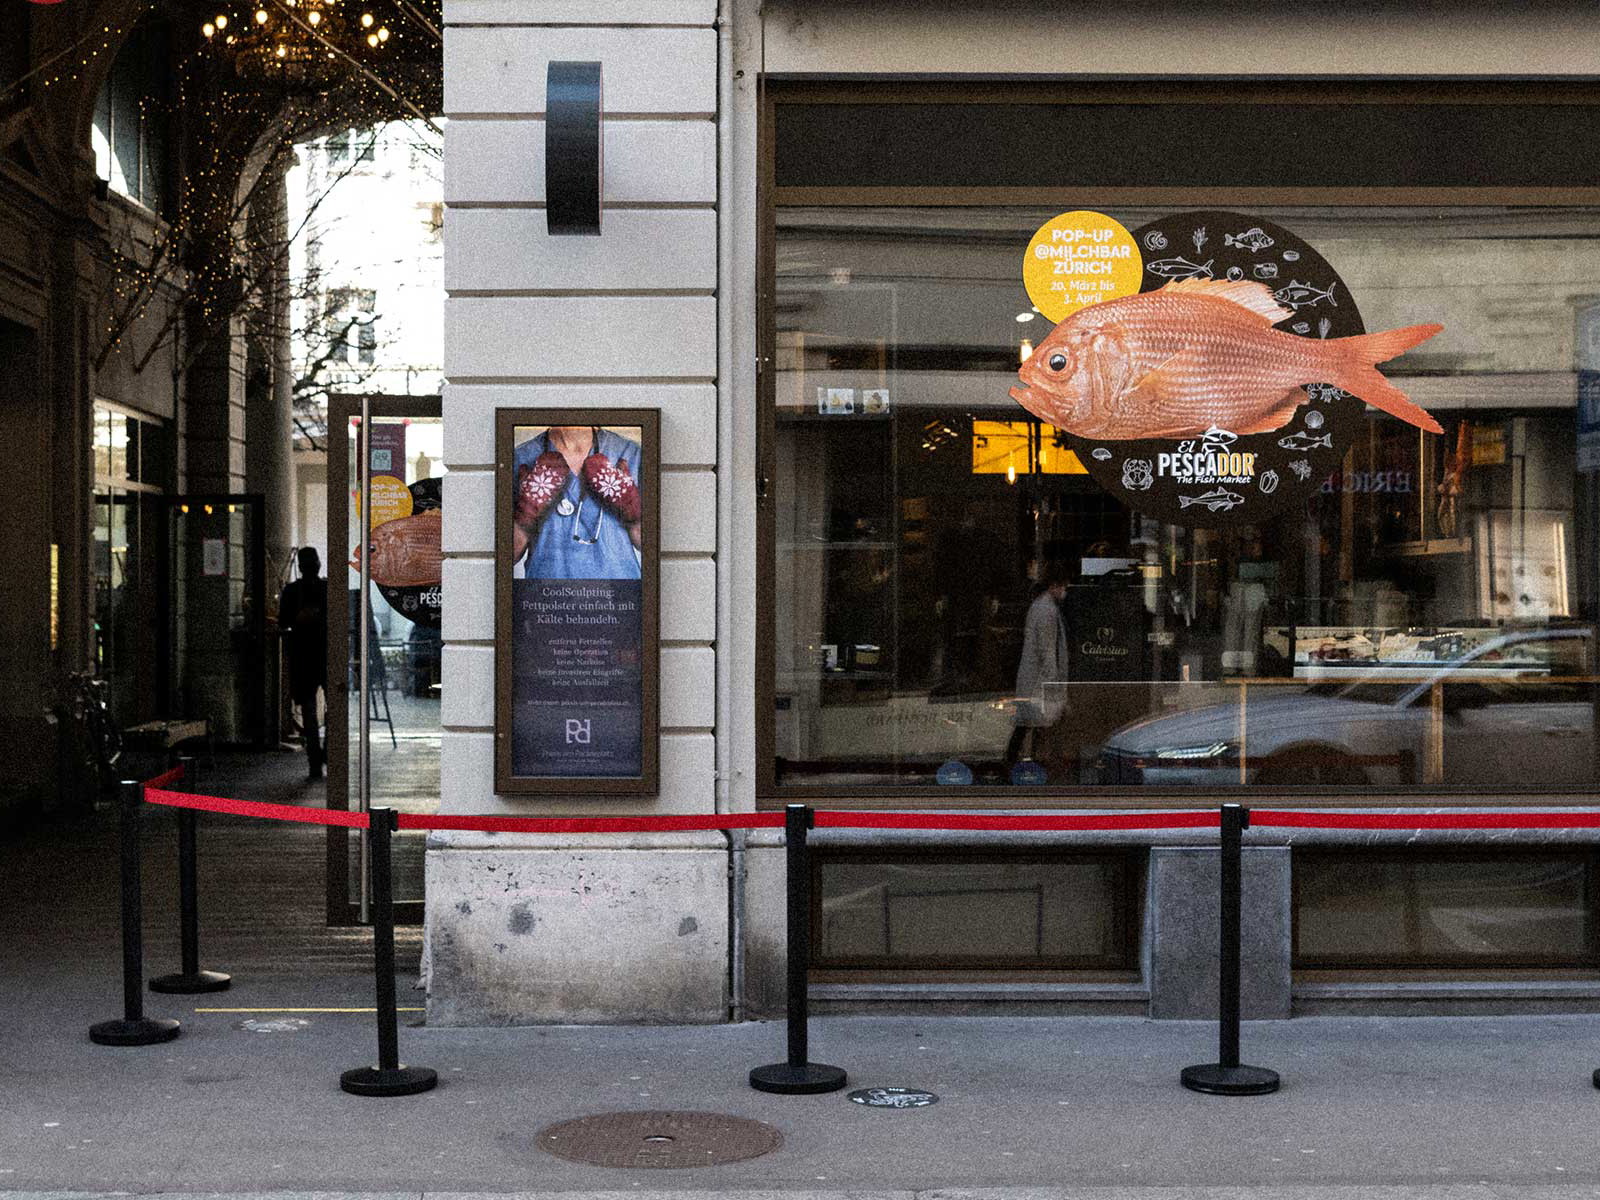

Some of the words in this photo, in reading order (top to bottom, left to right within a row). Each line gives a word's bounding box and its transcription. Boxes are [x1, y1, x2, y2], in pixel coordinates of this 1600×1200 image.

[1052, 229, 1113, 242] POP-UP
[1035, 244, 1130, 259] @MILCHBAR
[1054, 257, 1112, 274] ZÜRICH
[1100, 279, 1115, 290] bis
[1076, 292, 1102, 305] April
[1178, 440, 1196, 453] El
[1158, 453, 1255, 477] PESCADOR
[1176, 476, 1192, 484] The
[1195, 475, 1214, 484] Fish
[1216, 475, 1251, 484] Market
[522, 600, 576, 612] Fettpolster
[579, 600, 615, 611] einfach
[618, 600, 635, 611] mit
[537, 613, 563, 624] Kälte
